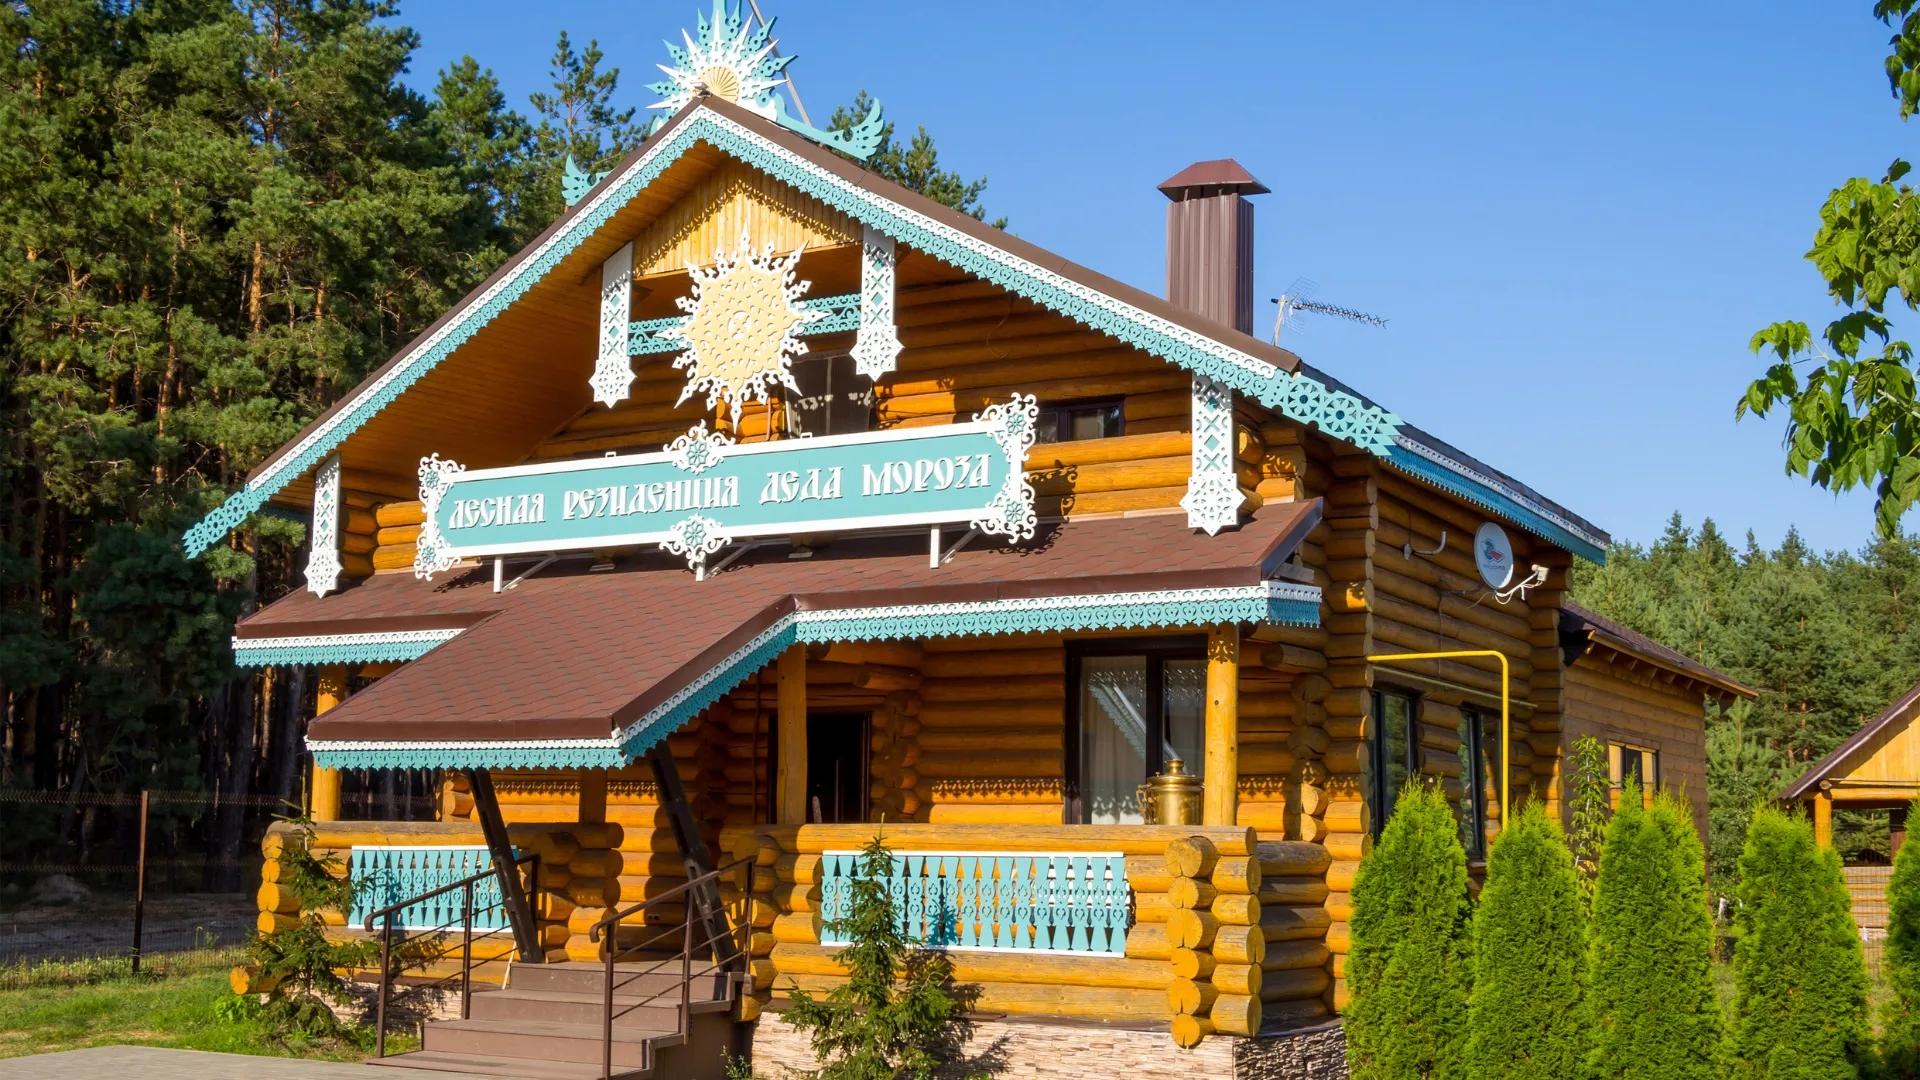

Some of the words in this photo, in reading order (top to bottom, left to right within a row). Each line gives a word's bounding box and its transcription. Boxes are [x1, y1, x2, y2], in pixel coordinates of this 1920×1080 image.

[448, 493, 545, 530] ЛЕСНАЯ
[563, 475, 740, 521] РЕЗИДЕНЦИЯ
[760, 466, 843, 505] ДЕДА
[862, 454, 991, 497] МОРОЗА
